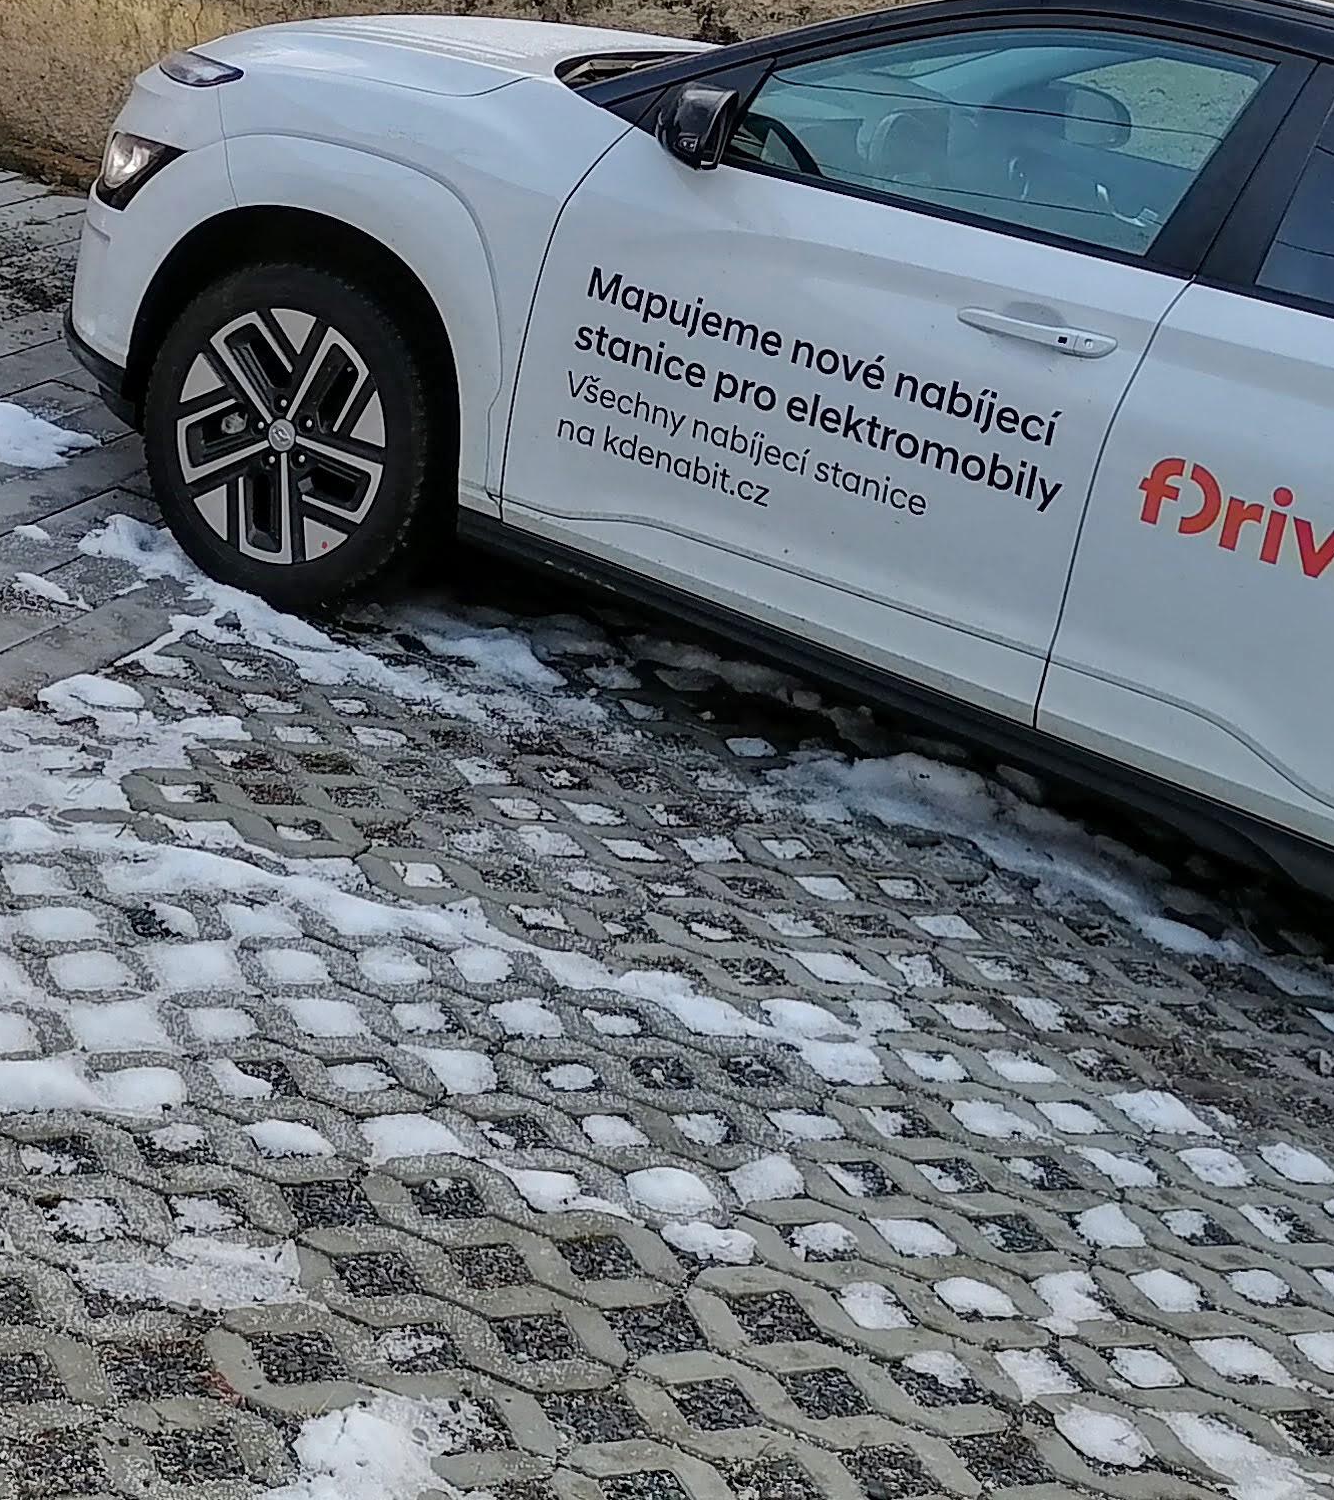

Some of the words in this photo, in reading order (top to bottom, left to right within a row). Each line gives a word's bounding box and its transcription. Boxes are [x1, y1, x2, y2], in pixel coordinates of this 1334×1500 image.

[574, 325, 706, 388] stanice
[713, 370, 776, 411] pro
[786, 393, 1062, 512] elektromobily
[587, 266, 782, 356] Mapujeme
[790, 338, 885, 389] nové
[893, 380, 1062, 446] nabíjecí
[557, 418, 595, 446] na
[603, 425, 770, 507] kdenabit.cz
[567, 370, 686, 436] Všechny
[692, 418, 810, 475] nabíjecí
[814, 460, 927, 515] stanice
